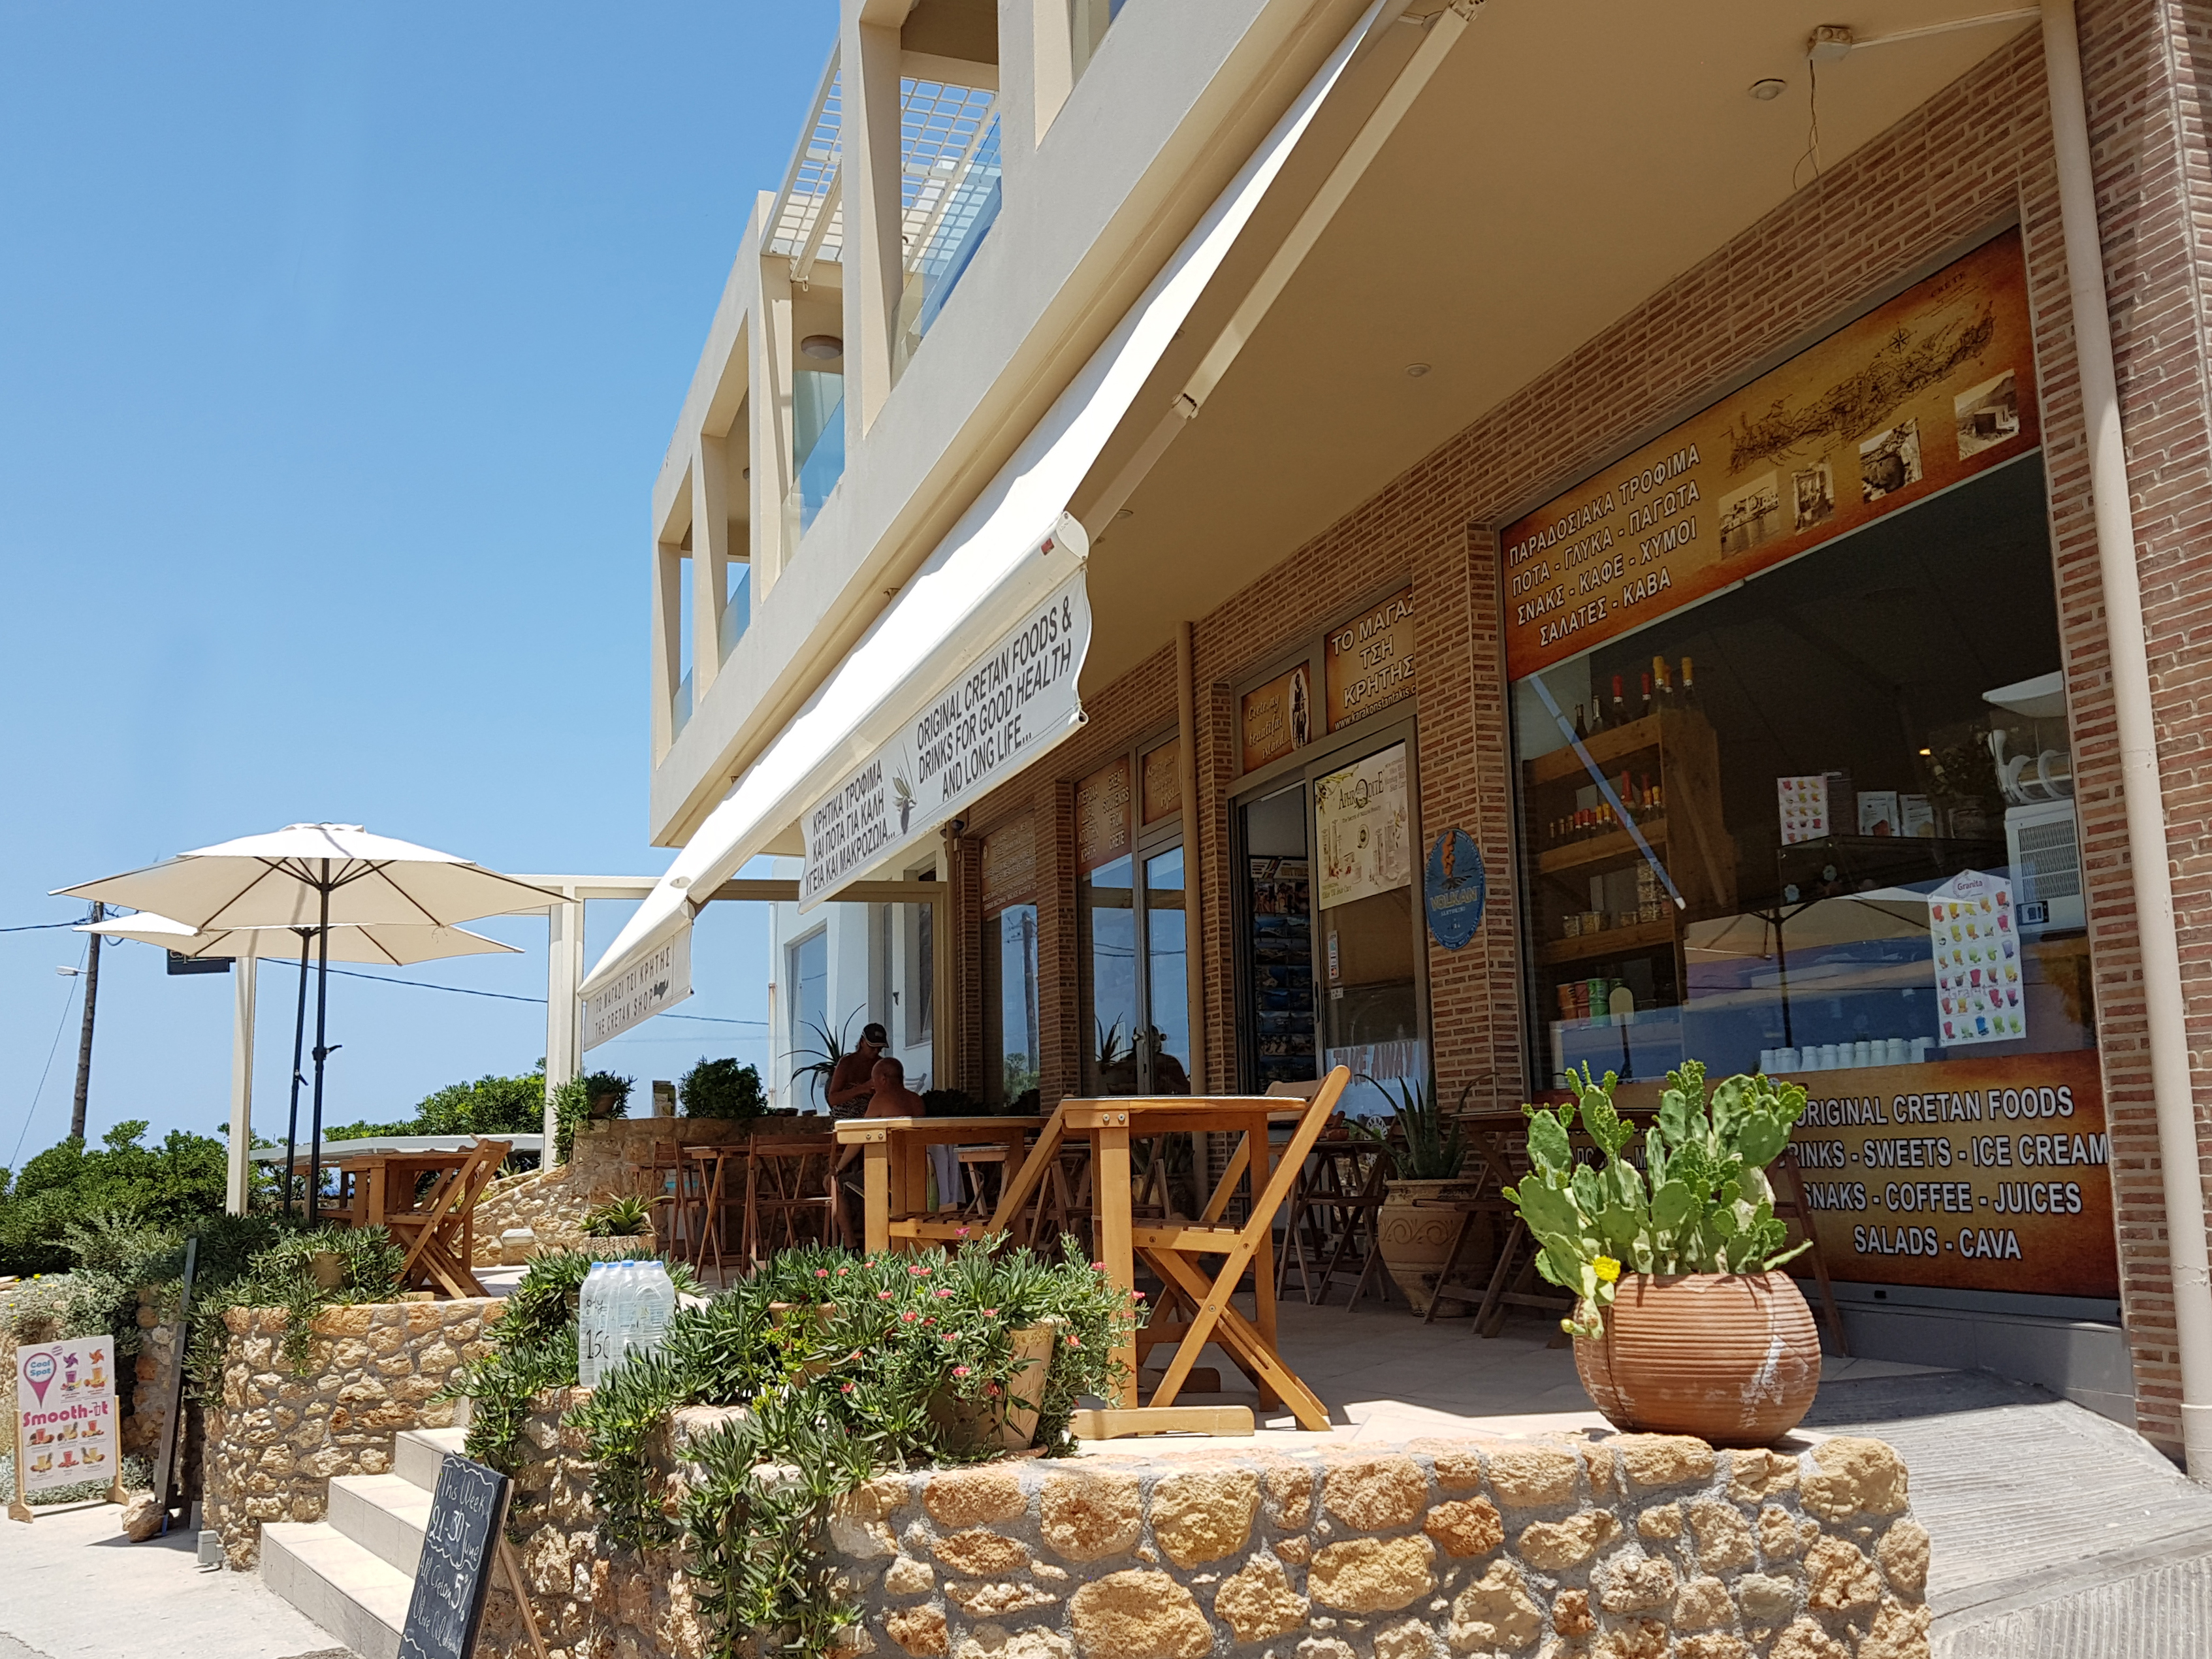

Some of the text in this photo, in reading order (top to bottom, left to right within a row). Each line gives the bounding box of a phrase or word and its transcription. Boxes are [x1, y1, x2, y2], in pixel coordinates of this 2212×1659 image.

[1509, 443, 1701, 568] ΠΑΡΑΔΟΣΙΑΚΑ ΤΡΟΦΙΜΑ
[1512, 561, 1550, 597] ΠΟΤΑ
[1565, 528, 1613, 570] ΓΛΥΚΑ
[1629, 479, 1700, 536] ΠΑΓΩΤΑ
[1518, 585, 1565, 626] ΣΝΑΚΣ
[1579, 554, 1624, 595] ΚΑΦΕ
[1641, 516, 1697, 565] ΧΥΜΟΙ
[1540, 597, 1607, 647] ΣΑΛΑΤΕΣ
[1623, 566, 1671, 609] ΚΑΒΑ
[1332, 629, 1354, 656] ΤΟ
[1360, 634, 1394, 669] ΤΣΗ
[918, 595, 1072, 751] ORIGINAL CRETAN FOODS &
[1343, 654, 1415, 709] ΚΡΗΤΗΣ
[919, 637, 1072, 784] DRINKS FOR GOOD HEALTH
[942, 713, 1032, 802] AND LONG LIFE...
[813, 759, 882, 837] ΚΡΗΤΙΚΑ ΤΡΟΦΙΜΑ
[812, 787, 884, 865] ΚΑΙ ΠΟΤΑ ΓΙΑ ΚΑΛΗ
[825, 854, 839, 881] ΚΑΙ
[1957, 880, 1983, 890] Granita
[1430, 886, 1478, 911] VOLKAN
[596, 998, 602, 1014] ΤΟ
[604, 980, 624, 1008] ΜΑΓΑΖΙ
[640, 946, 670, 984] ΚΡΗΤΗΣ
[595, 988, 653, 1038] THE CRETAN SHOP
[1371, 1041, 1413, 1080] AWAY
[1893, 1090, 1981, 1123] CRETAN
[1988, 1086, 2074, 1119] FOODS
[1778, 1140, 1846, 1168] RINKS
[1863, 1137, 1951, 1168] SWEETS
[1972, 1135, 2012, 1167] ICE
[2018, 1132, 2108, 1166] CREAM
[1803, 1182, 1867, 1210] SNAKS
[1885, 1182, 1973, 1213] COFFEE
[1993, 1182, 2082, 1214] JUICES
[1853, 1225, 1938, 1257] SALADS
[1959, 1229, 2022, 1261] CAVA
[30, 1360, 50, 1368] Cool
[30, 1368, 51, 1377] Spot
[460, 1475, 486, 1519] Week
